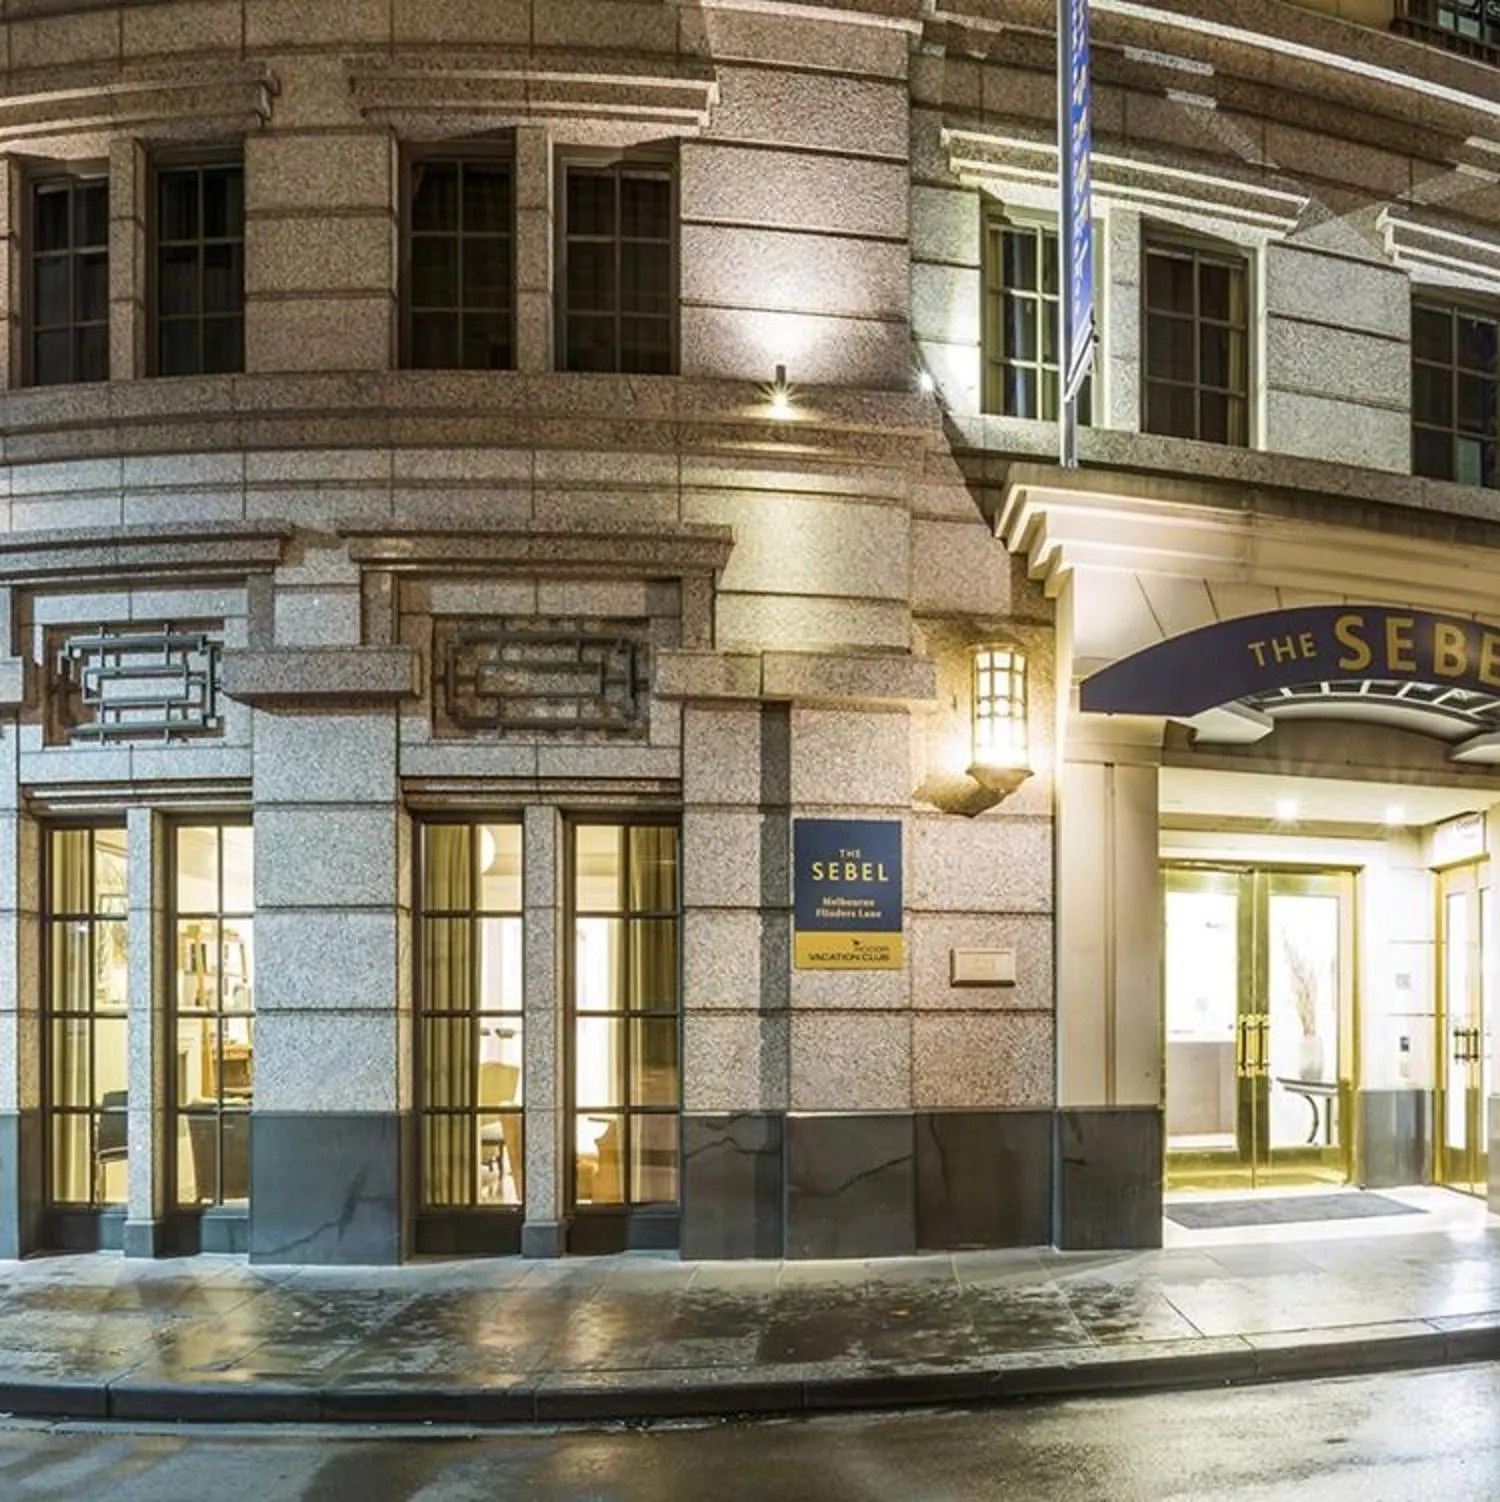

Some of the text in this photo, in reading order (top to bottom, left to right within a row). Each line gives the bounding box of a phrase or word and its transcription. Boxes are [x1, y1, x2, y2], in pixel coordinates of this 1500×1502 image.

[1248, 632, 1318, 669] THE
[838, 849, 862, 859] THE
[811, 862, 890, 882] SEBEL
